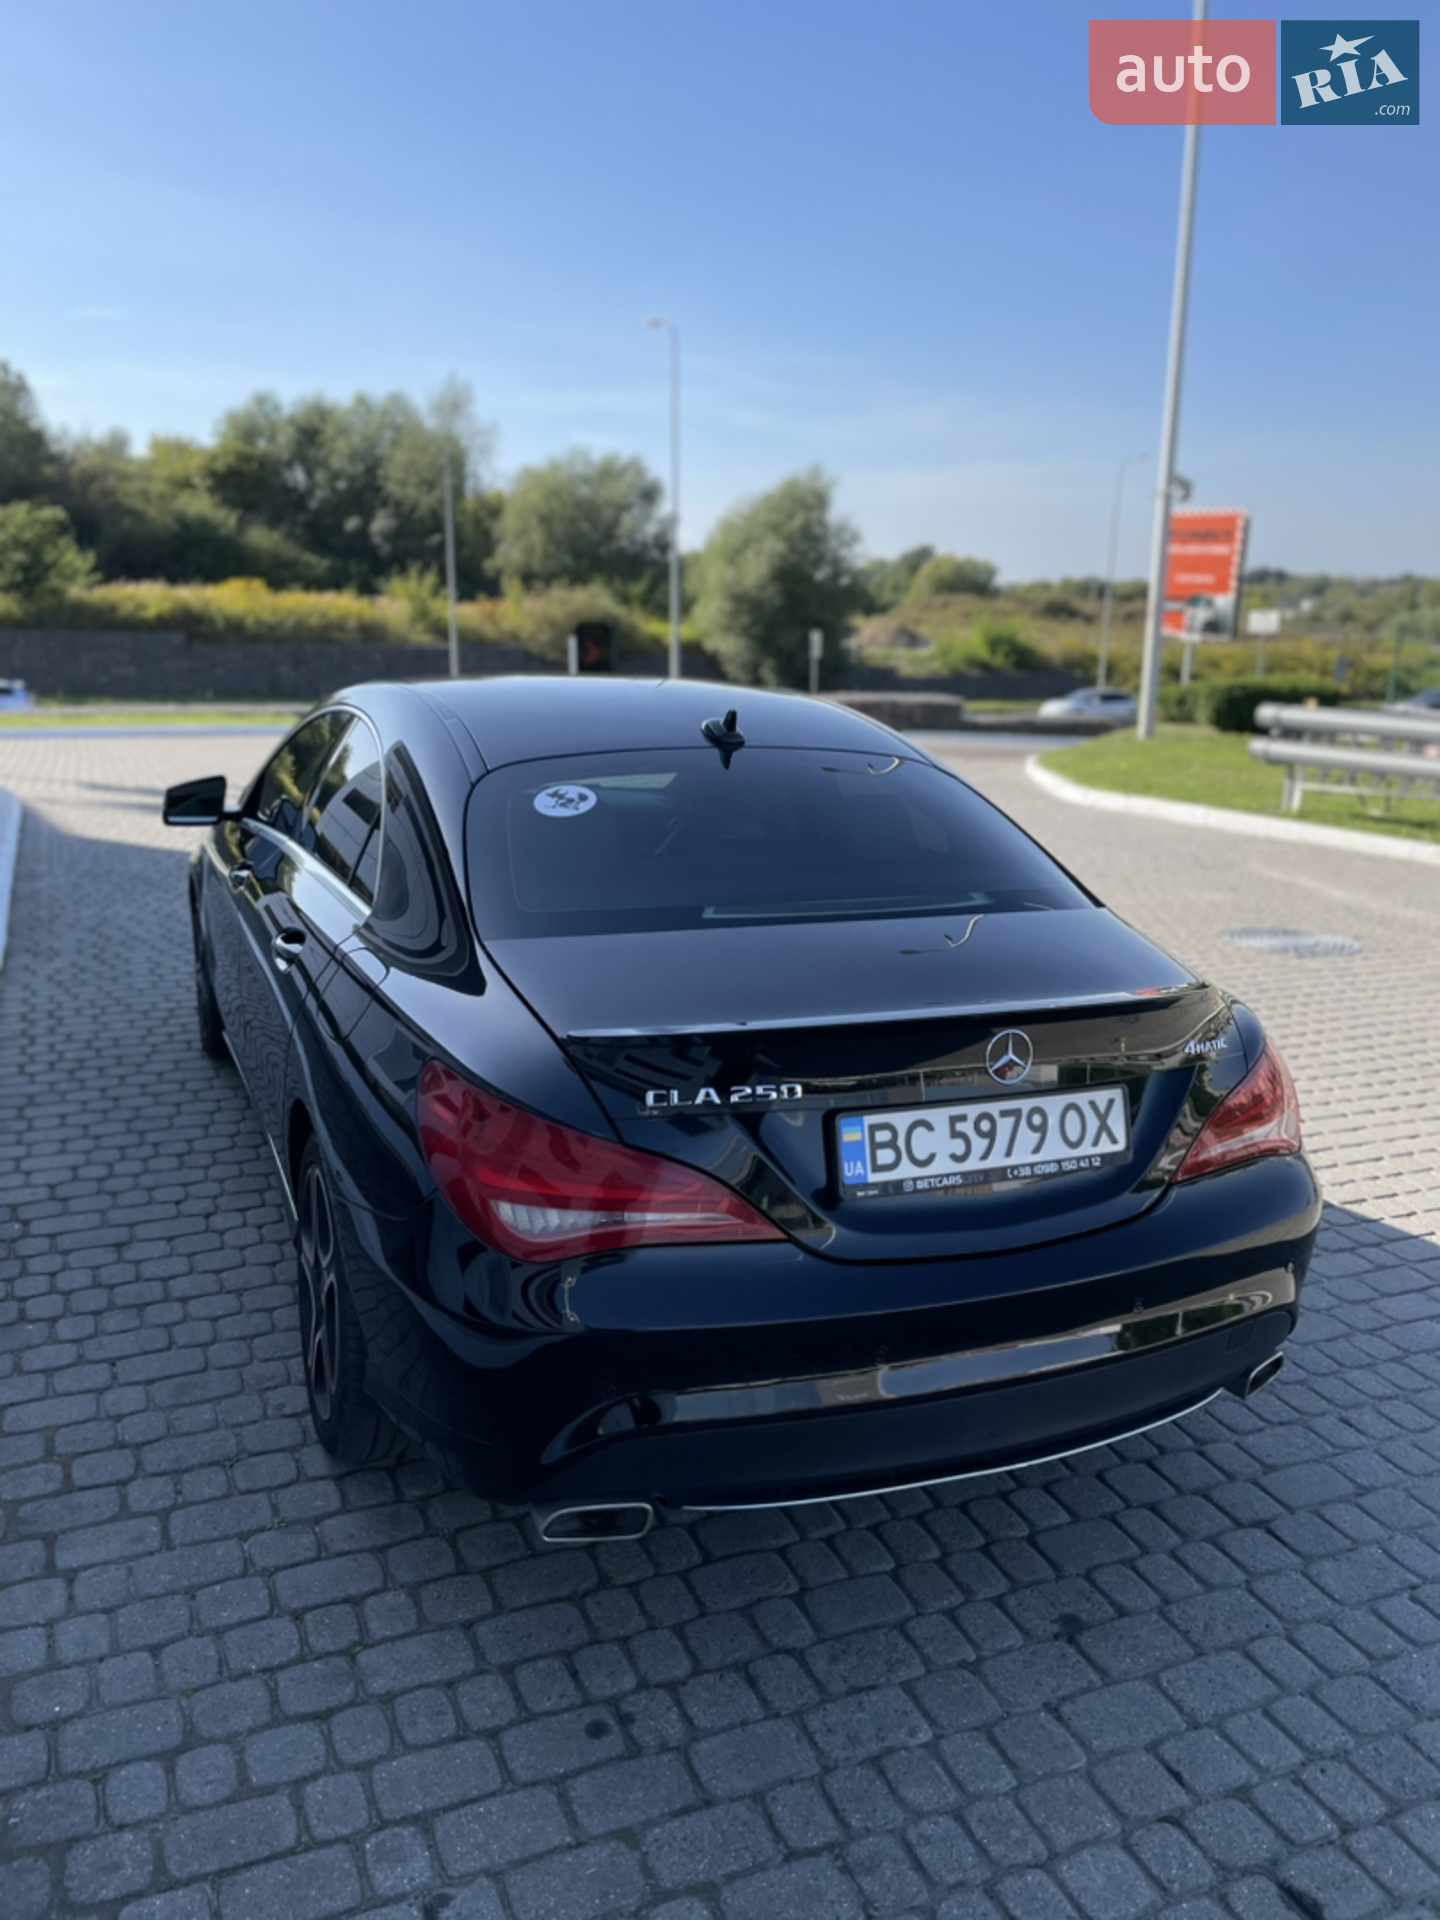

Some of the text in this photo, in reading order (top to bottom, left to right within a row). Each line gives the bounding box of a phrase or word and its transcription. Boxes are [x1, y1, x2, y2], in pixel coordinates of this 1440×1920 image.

[1184, 1037, 1228, 1055] 4MATIC
[645, 1083, 803, 1107] CLA 250
[867, 1098, 1120, 1174] BC 5979 OX
[844, 1162, 865, 1177] UA
[916, 1174, 963, 1189] BETCARS
